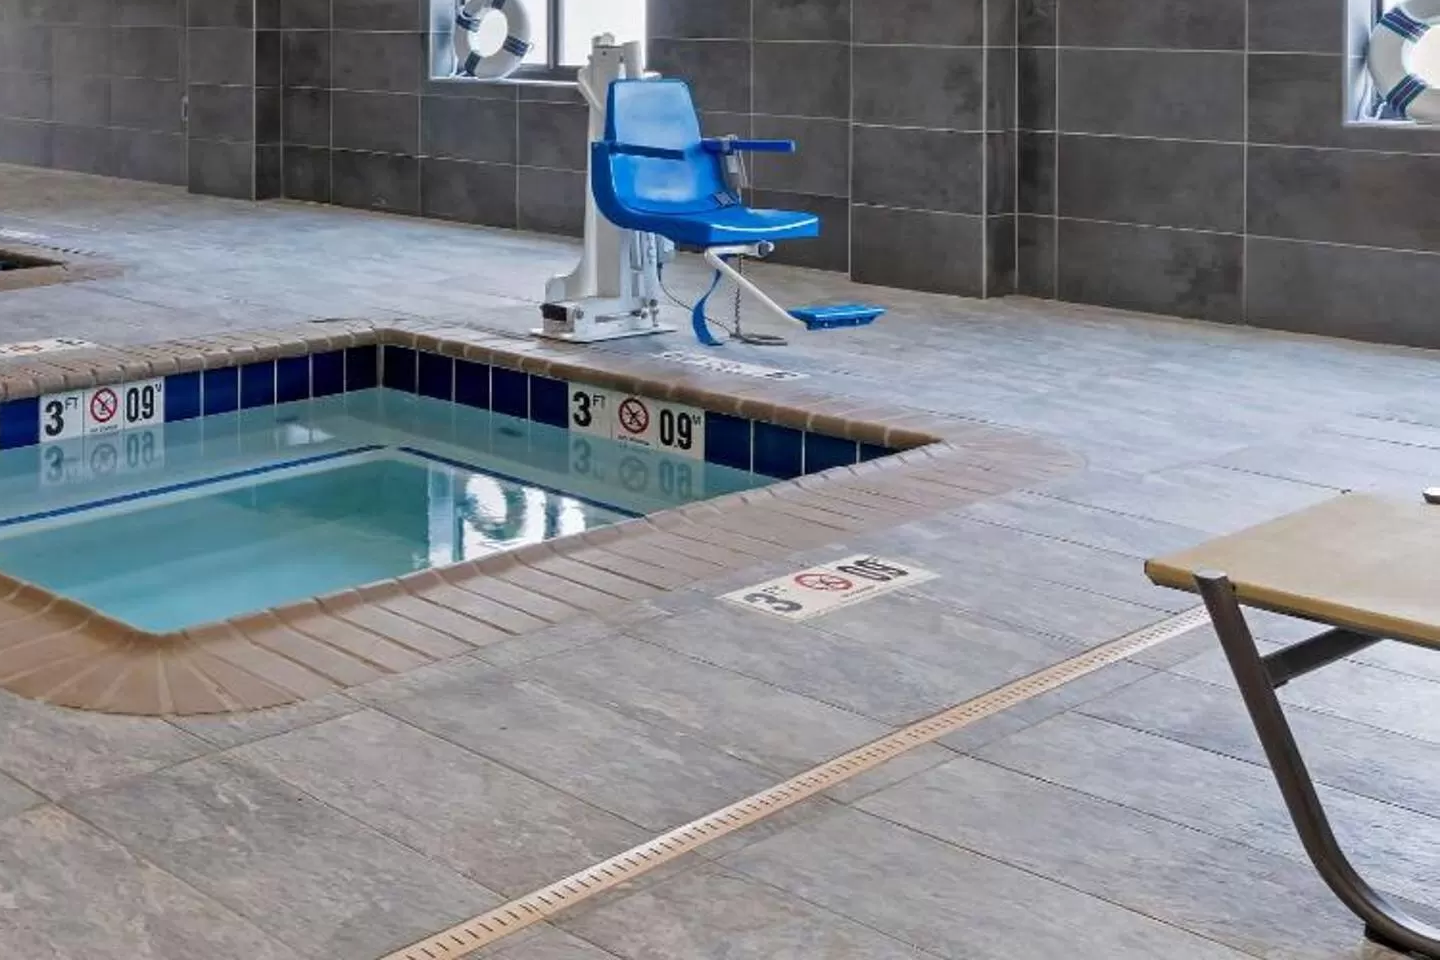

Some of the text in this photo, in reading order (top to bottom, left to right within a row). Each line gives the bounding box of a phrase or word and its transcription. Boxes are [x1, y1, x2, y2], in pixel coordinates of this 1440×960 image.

[45, 400, 64, 436] 3
[573, 391, 592, 427] 3
[744, 592, 803, 612] 3
